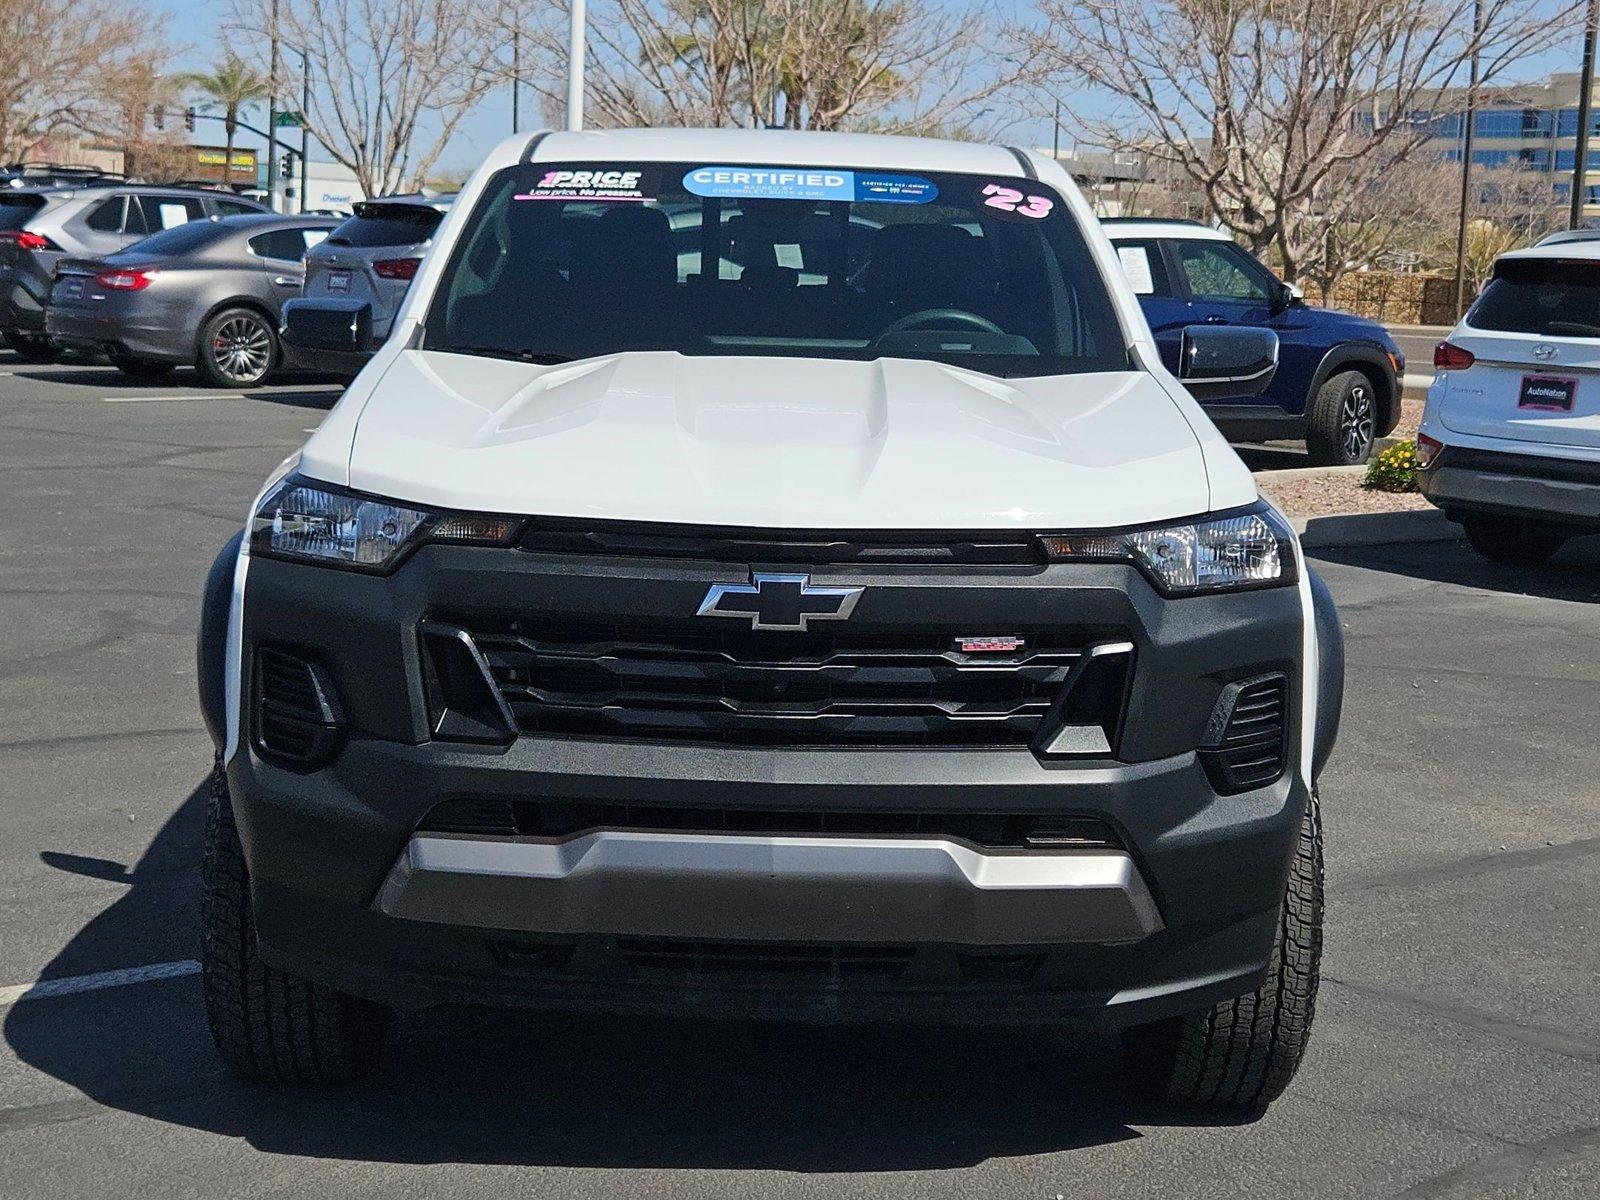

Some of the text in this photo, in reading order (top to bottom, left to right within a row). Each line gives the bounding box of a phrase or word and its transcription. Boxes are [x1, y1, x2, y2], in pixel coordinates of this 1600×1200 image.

[693, 171, 845, 187] CERTIFIED
[529, 188, 551, 196] Low
[981, 183, 1054, 219] '23
[1527, 387, 1567, 399] AutoNation
